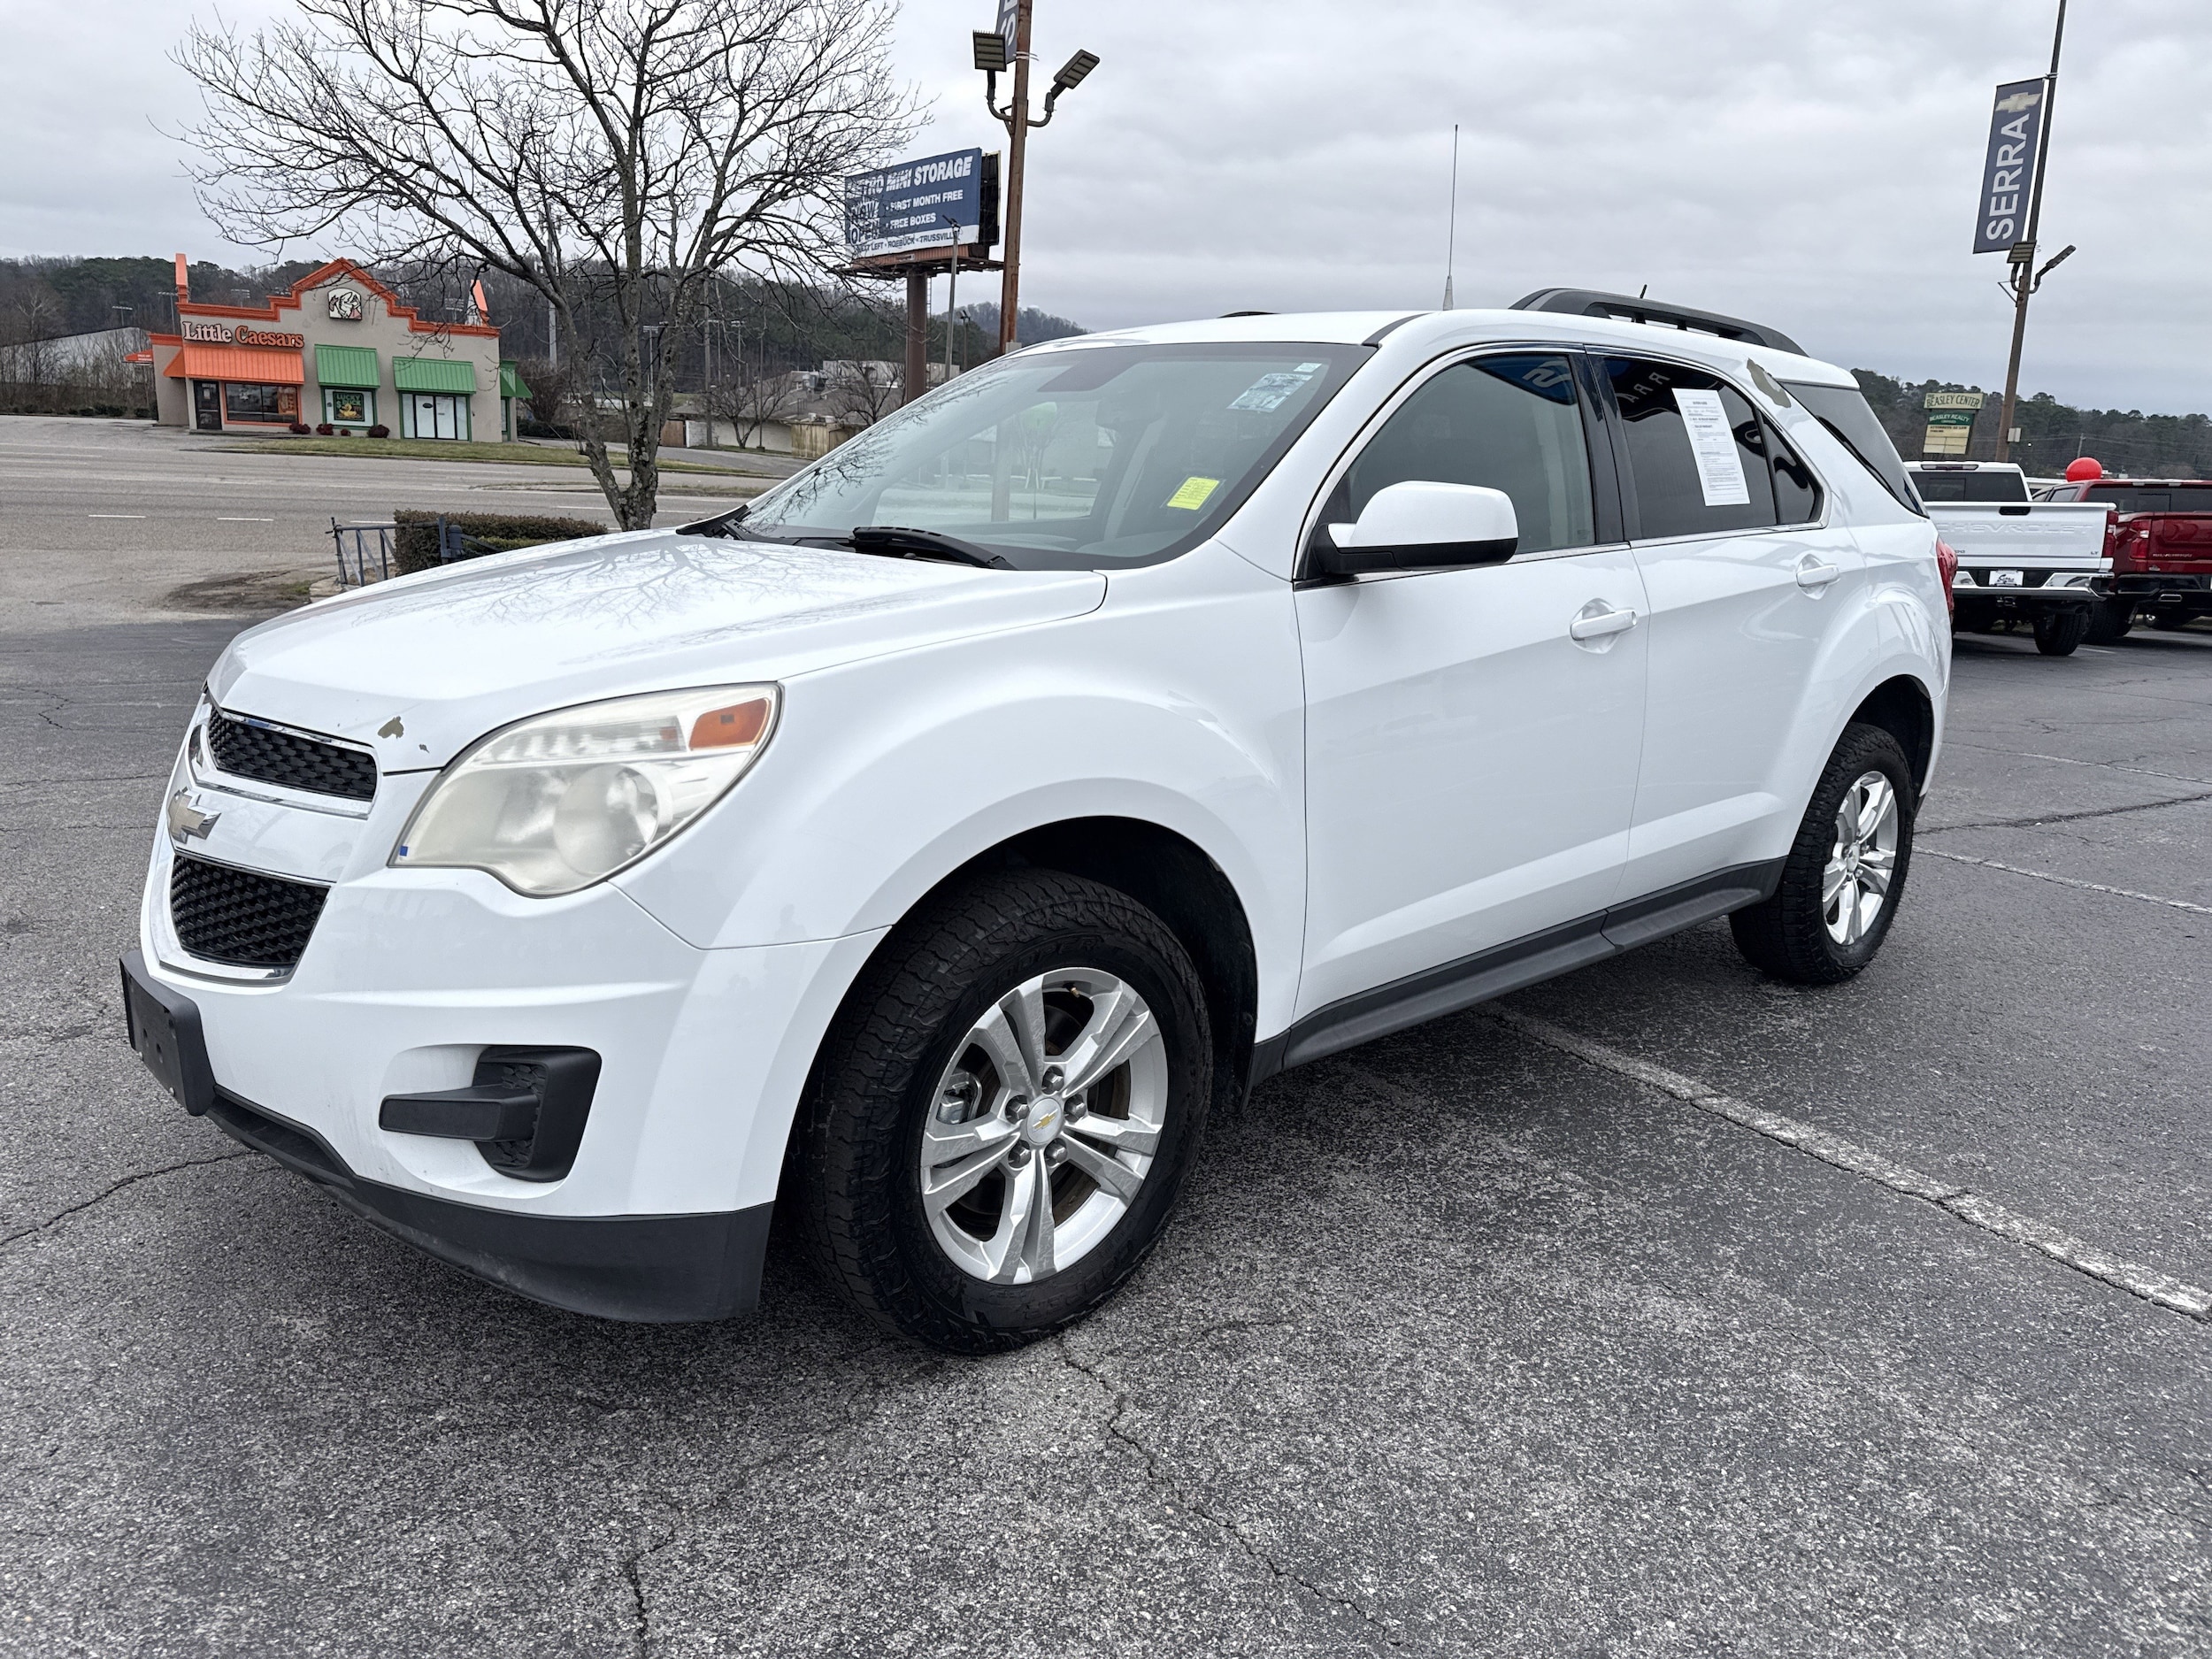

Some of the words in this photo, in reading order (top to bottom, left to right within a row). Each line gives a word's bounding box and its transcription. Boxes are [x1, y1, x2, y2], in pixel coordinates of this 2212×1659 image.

[914, 156, 973, 186] STORAGE
[1986, 113, 2030, 240] SERRA
[890, 198, 911, 211] FIRST
[913, 194, 941, 207] MONTH
[942, 189, 964, 202] FREE
[890, 218, 909, 230] FREE
[910, 212, 937, 227] BOXES
[872, 242, 883, 251] LEFT
[887, 237, 915, 248] ROEBUCK
[919, 230, 958, 242] TRUSSVILL
[182, 321, 232, 342] Little
[235, 325, 304, 348] Caesars
[1926, 395, 1955, 407] BEASLEY
[1956, 395, 1980, 407] CENTER
[1929, 413, 1950, 422] BEASLEY
[1951, 413, 1970, 422] REALTY
[1938, 522, 2093, 534] CHEVROLET
